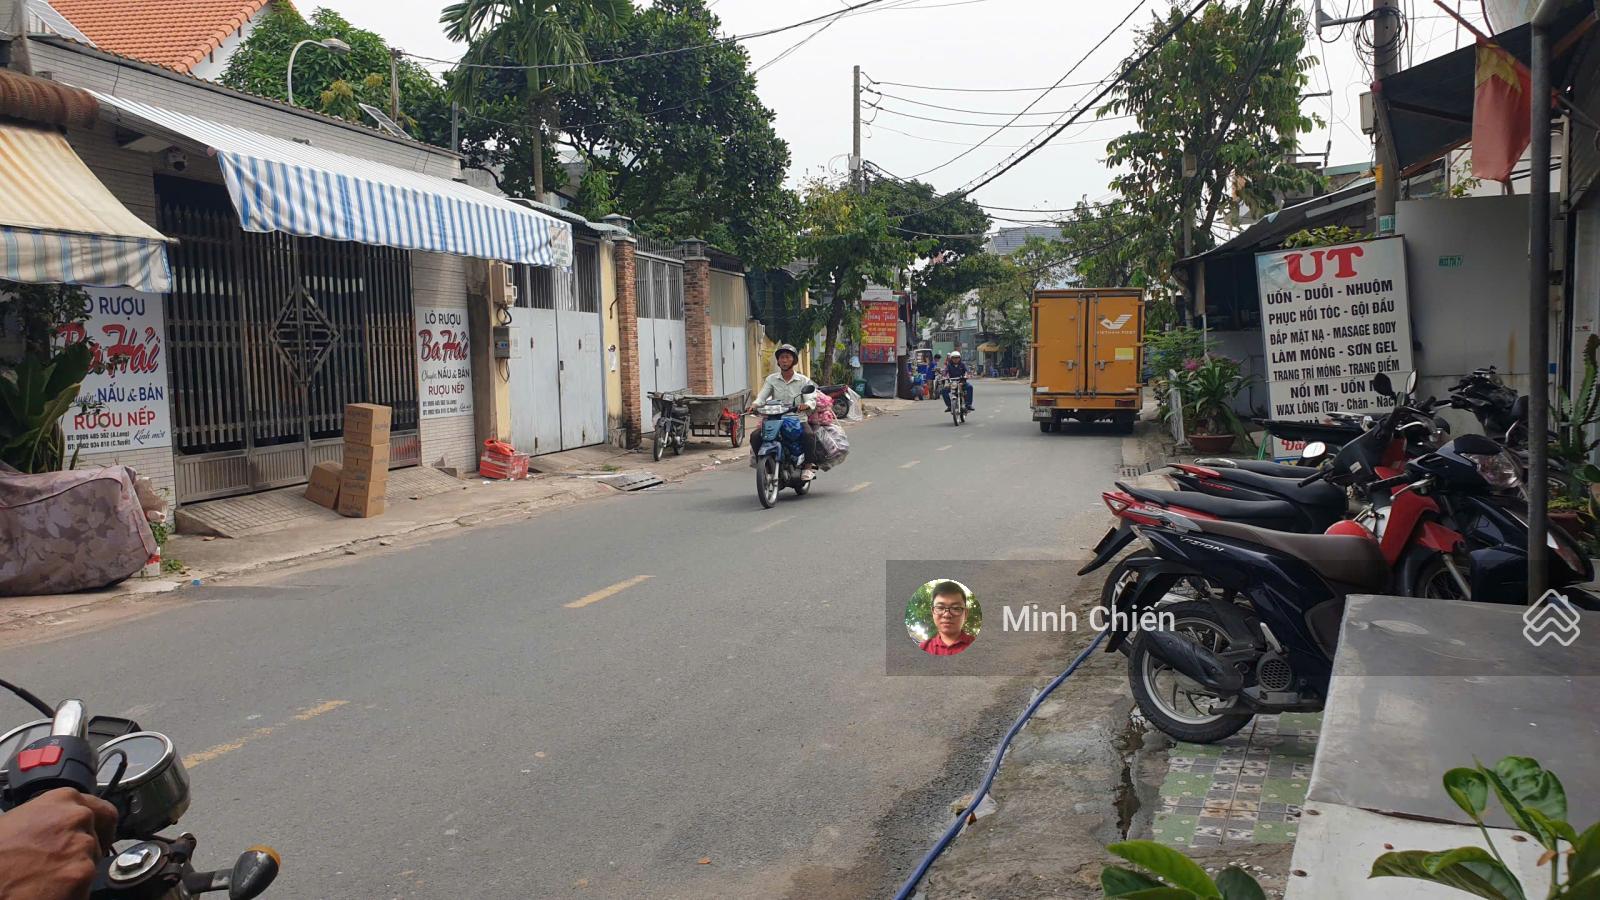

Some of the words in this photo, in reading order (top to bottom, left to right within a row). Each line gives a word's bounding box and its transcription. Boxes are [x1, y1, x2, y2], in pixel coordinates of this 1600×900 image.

[1267, 288, 1292, 305] UỐN
[1346, 278, 1393, 296] NHUỘM
[99, 296, 145, 320] RƯỢU
[1269, 311, 1297, 326] PHỤC
[1351, 301, 1369, 318] GỘI
[438, 313, 461, 328] RƯỢU
[1290, 329, 1309, 345] MẶT
[1311, 328, 1325, 343] NẠ
[1333, 323, 1370, 339] MASAGE
[1372, 320, 1396, 335] BODY
[102, 324, 161, 379] Hải
[418, 329, 441, 362] Ba
[440, 329, 469, 364] Hải
[1272, 349, 1297, 364] LÀM
[1300, 345, 1336, 361] MÓNG
[1347, 342, 1372, 356] SƠN
[1375, 340, 1398, 354] GEL
[1273, 368, 1300, 381] TRANG
[1349, 361, 1376, 375] TRANG
[98, 382, 125, 403] NẤU
[127, 388, 137, 402] &
[139, 382, 164, 401] BÁN
[428, 384, 450, 398] RƯỢU
[451, 380, 465, 394] NẾP
[1290, 382, 1311, 399] NỐI
[1314, 384, 1329, 397] MI
[1340, 377, 1366, 394] UỐN
[74, 410, 122, 432] RƯỢU
[128, 404, 156, 427] NẾP
[1276, 403, 1295, 416] WAX
[1297, 400, 1320, 414] LÔNG
[1322, 400, 1339, 413] (Tay
[1346, 397, 1369, 410] Chân
